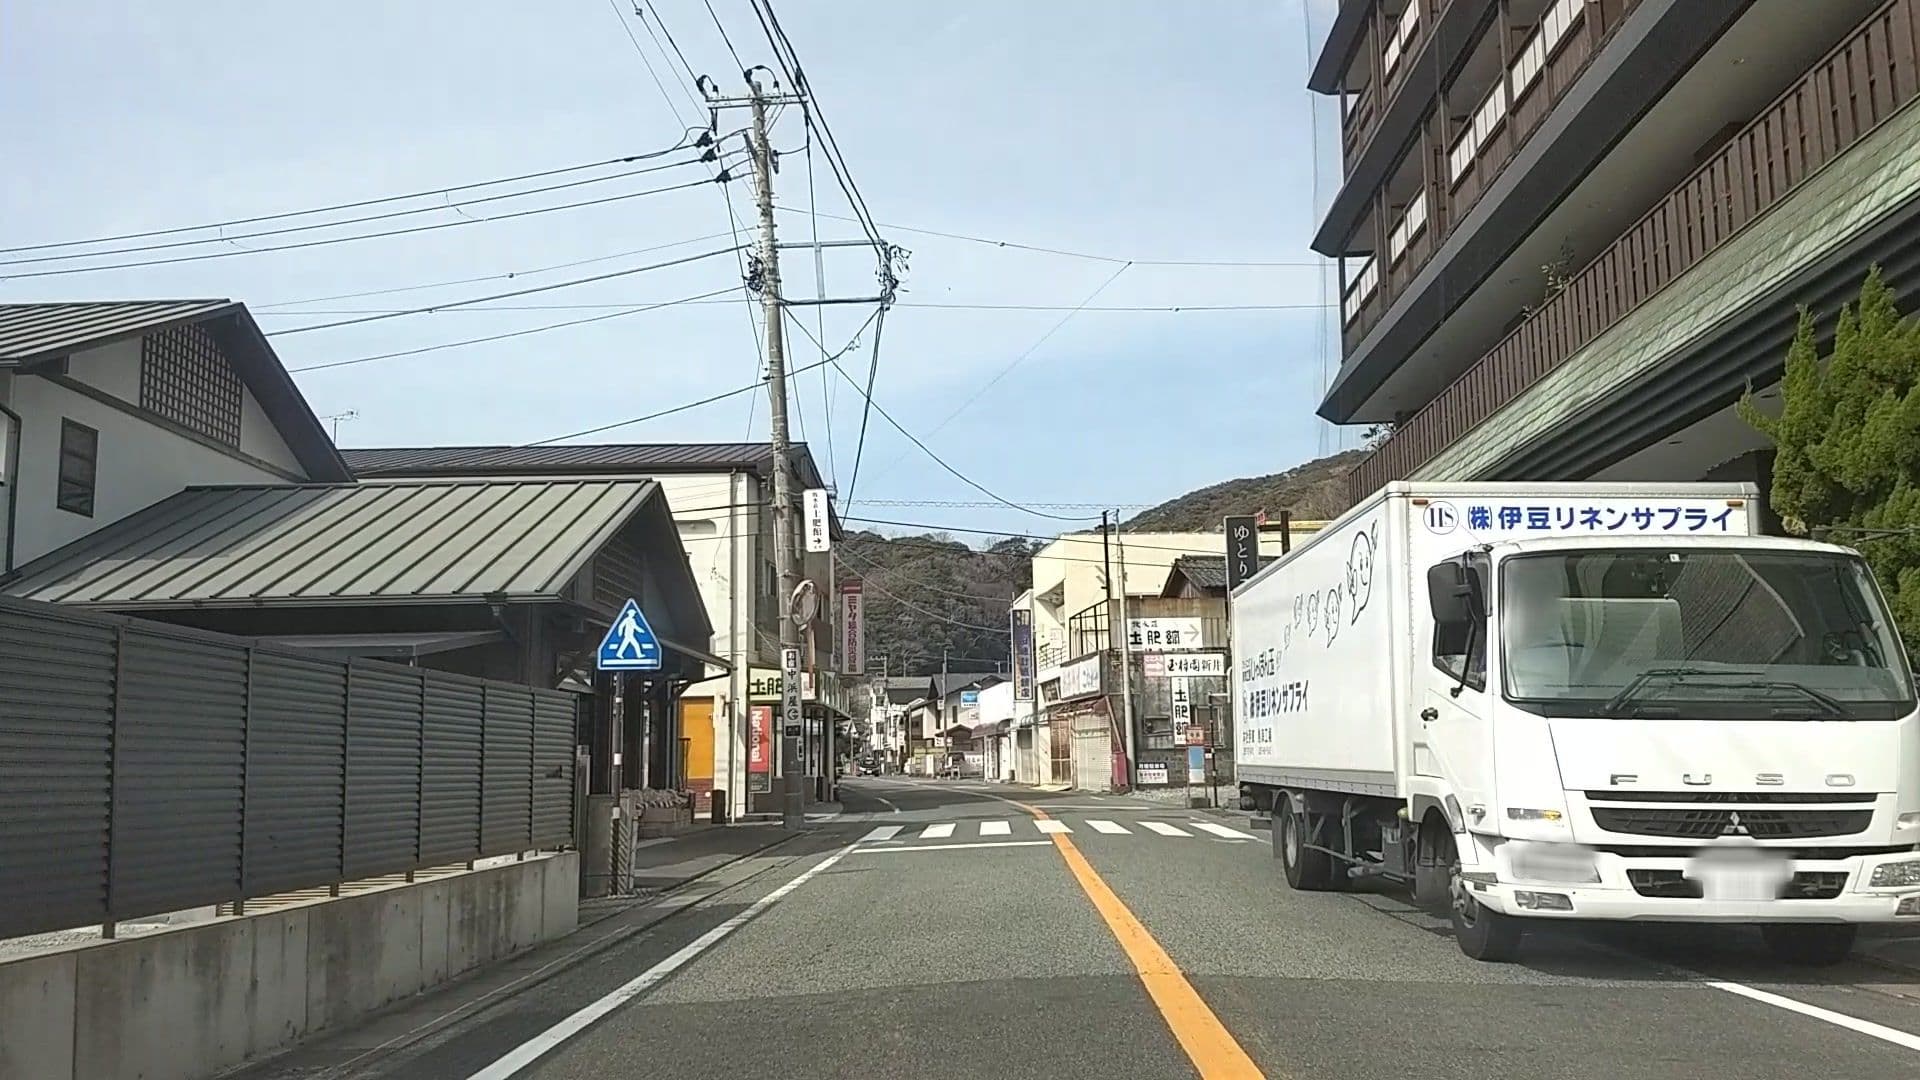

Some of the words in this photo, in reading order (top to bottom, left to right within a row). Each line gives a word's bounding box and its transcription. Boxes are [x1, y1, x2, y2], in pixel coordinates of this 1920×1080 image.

[1468, 505, 1733, 531] (株)伊豆リネンサプライ
[1234, 525, 1249, 581] ゆとり
[751, 710, 764, 763] National
[1610, 773, 1855, 786] FUSO
